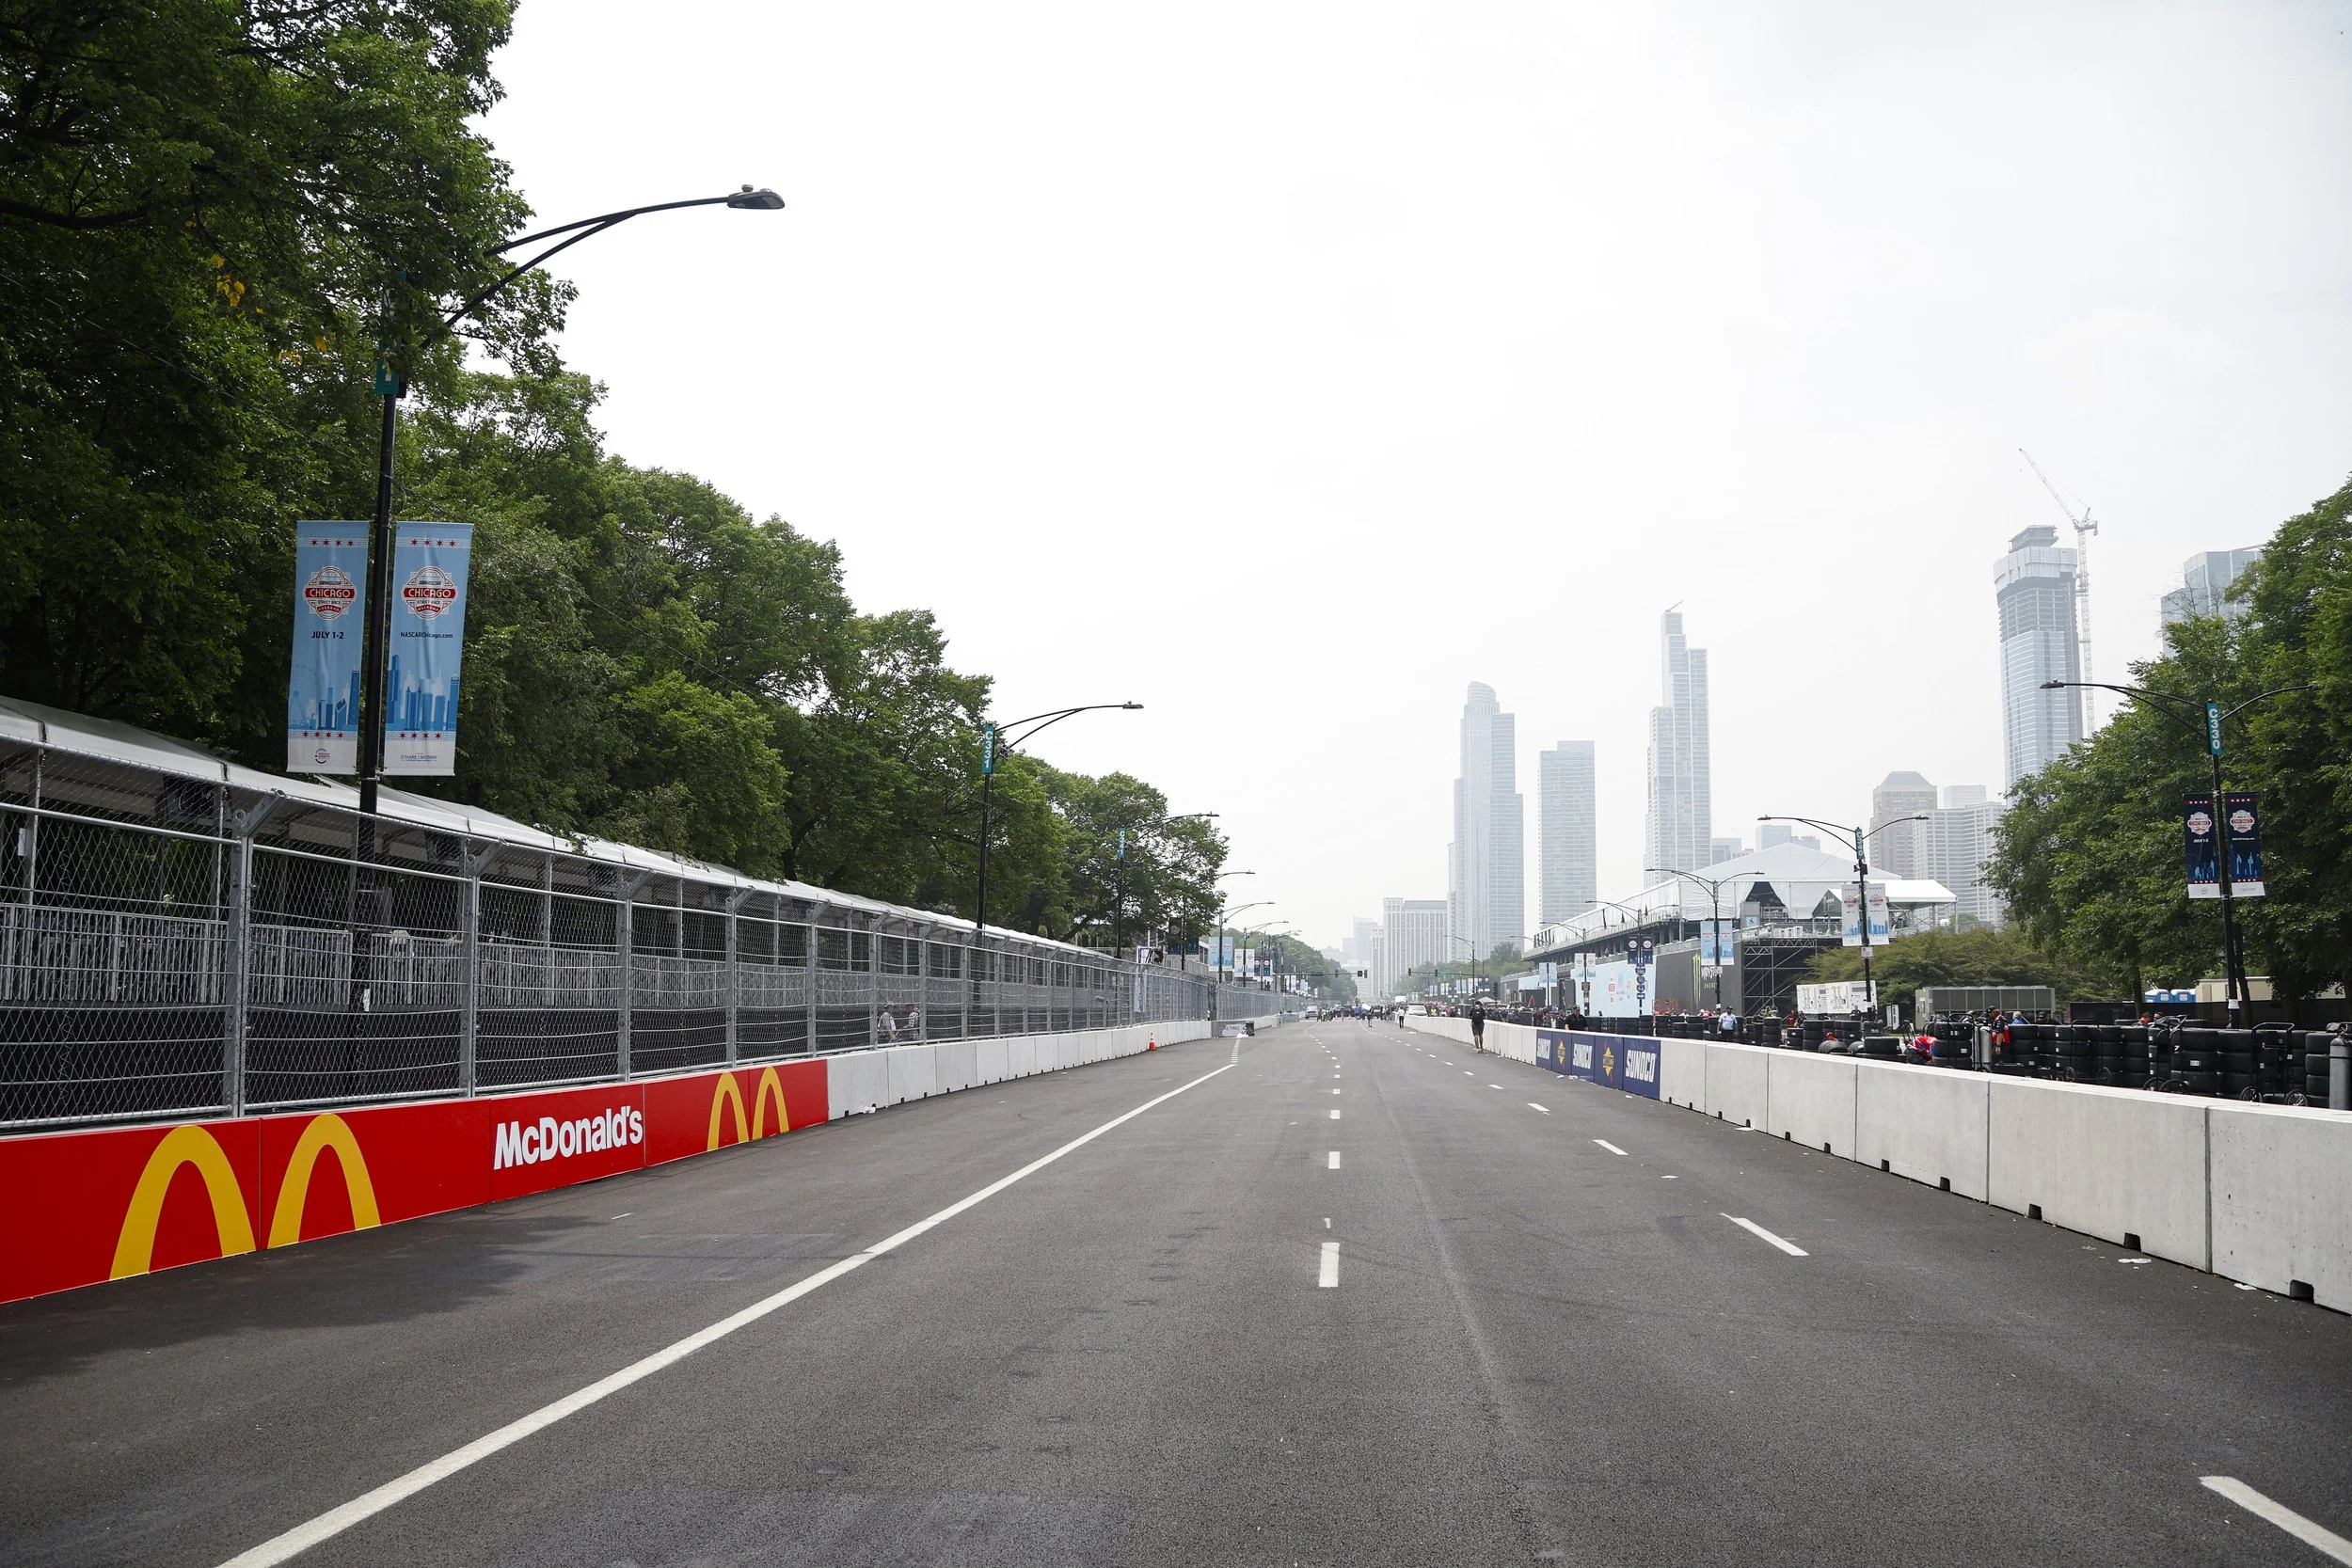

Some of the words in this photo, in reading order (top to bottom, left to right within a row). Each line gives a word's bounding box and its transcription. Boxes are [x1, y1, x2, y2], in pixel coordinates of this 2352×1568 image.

[310, 588, 351, 598] CHICAGO
[408, 588, 452, 598] CHICAGO
[400, 631, 453, 640] NASCARChicago.com
[2208, 708, 2220, 750] C330
[984, 731, 993, 768] C331
[1572, 1043, 1593, 1069] SUNOCO
[1625, 1049, 1656, 1083] SUNOCO
[493, 1105, 644, 1170] McDonald's
